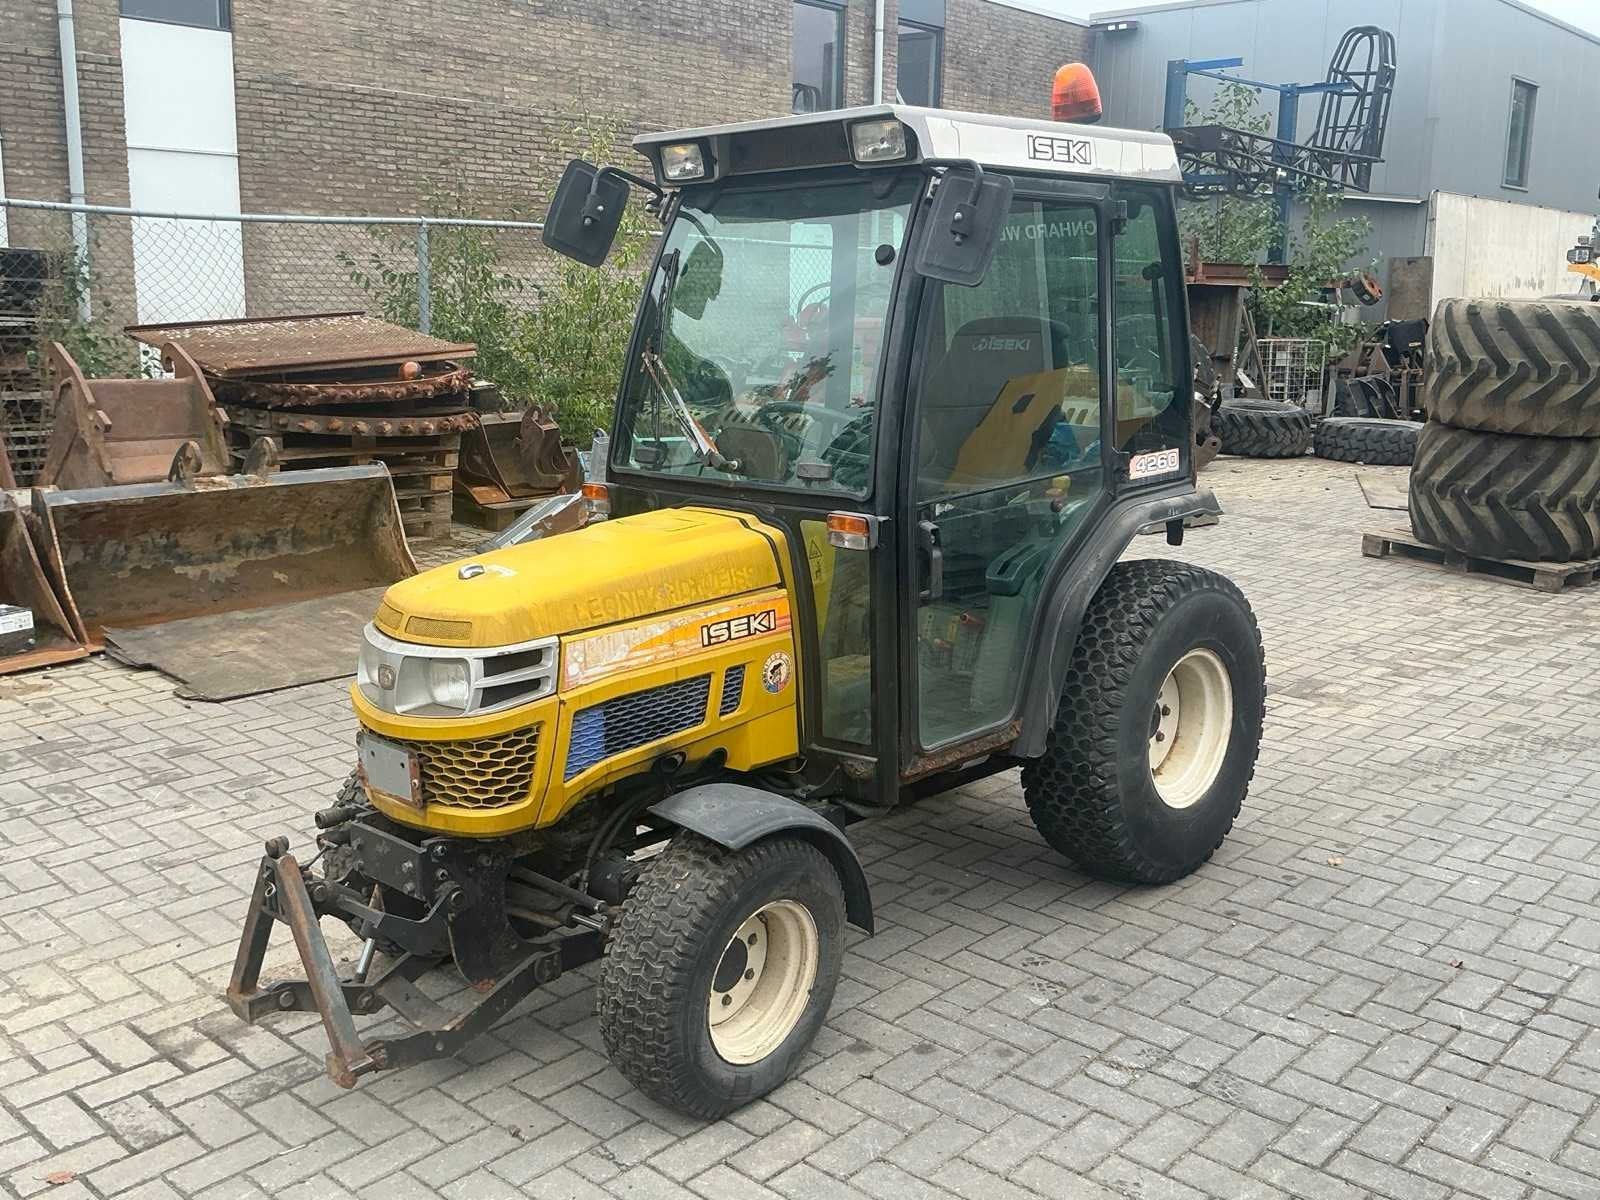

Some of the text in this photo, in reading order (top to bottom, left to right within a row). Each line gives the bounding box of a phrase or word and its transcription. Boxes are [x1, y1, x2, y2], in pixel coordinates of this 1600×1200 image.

[1027, 135, 1091, 165] ISEKI
[988, 336, 1031, 351] ISEKI
[1136, 452, 1177, 473] 4260
[701, 609, 776, 648] ISEKI
